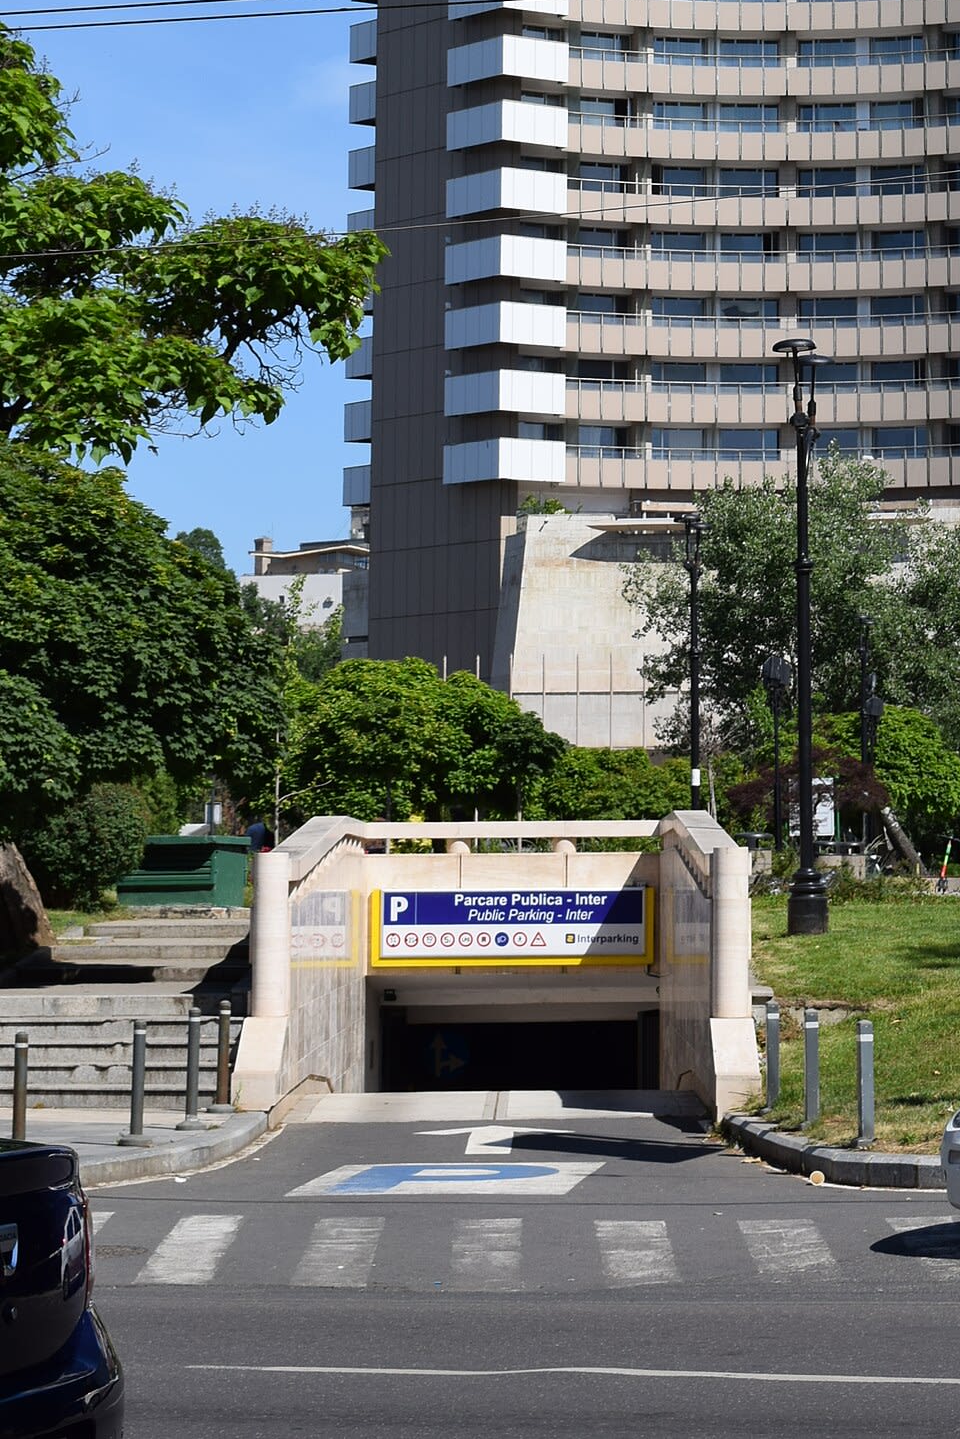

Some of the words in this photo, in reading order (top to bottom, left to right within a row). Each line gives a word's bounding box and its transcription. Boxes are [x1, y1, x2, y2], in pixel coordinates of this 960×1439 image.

[454, 893, 507, 906] Parcare
[511, 893, 563, 906] Publica
[575, 893, 607, 905] Inter
[390, 896, 409, 922] P
[468, 909, 505, 921] Public
[508, 908, 554, 923] Parking
[565, 908, 594, 920] Inter
[577, 933, 639, 944] Interparking
[322, 1164, 560, 1194] P
